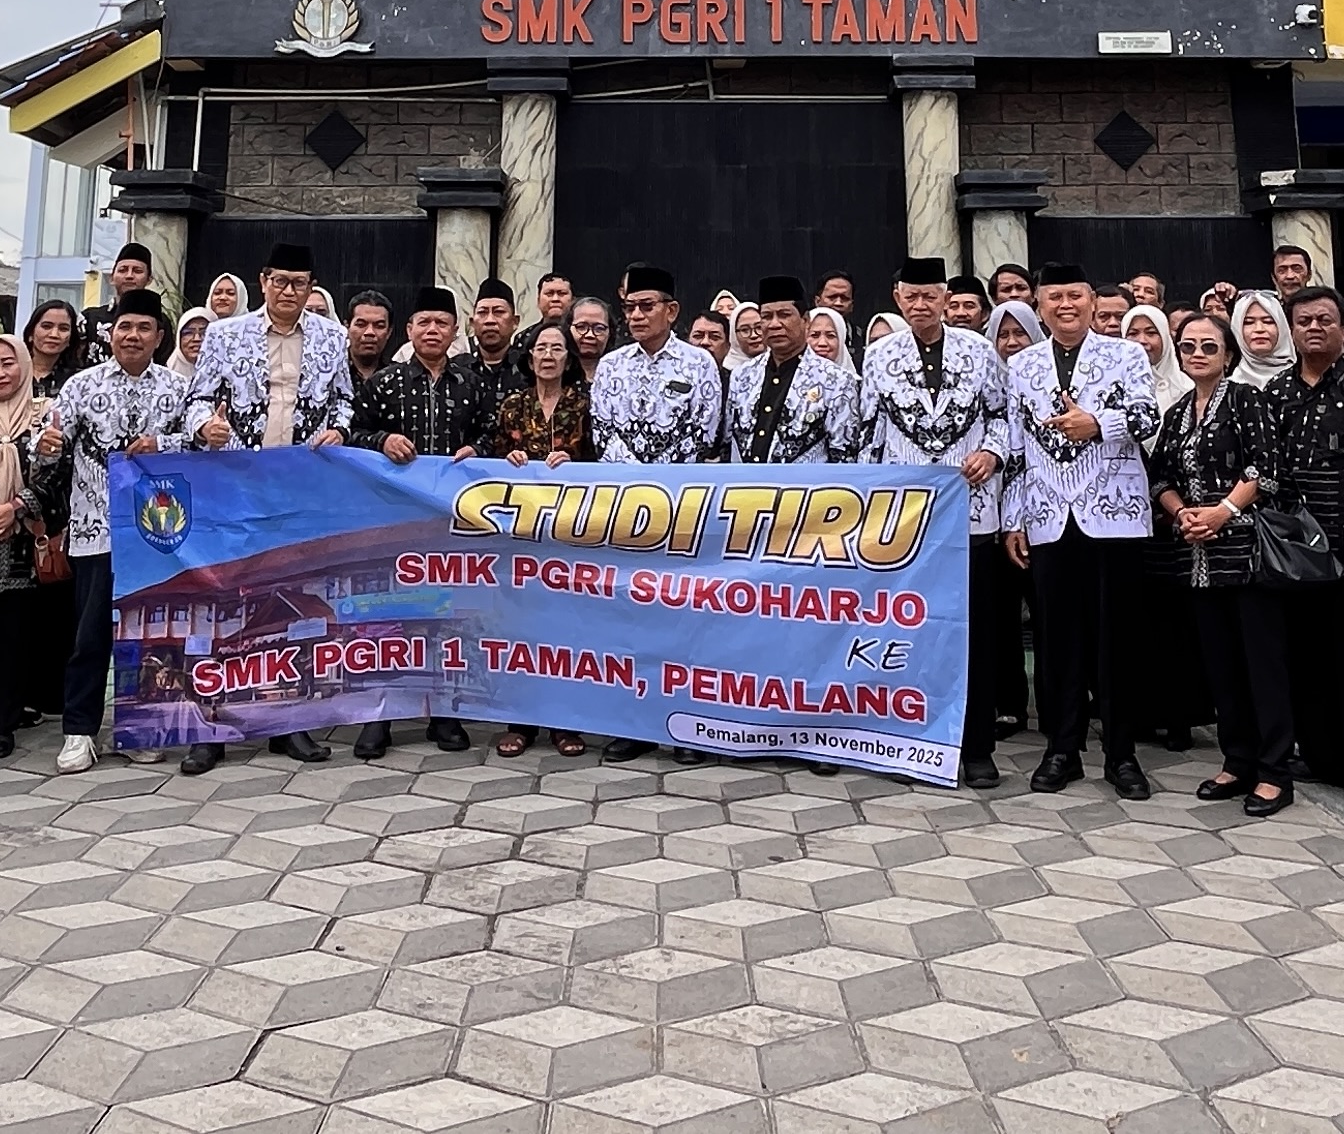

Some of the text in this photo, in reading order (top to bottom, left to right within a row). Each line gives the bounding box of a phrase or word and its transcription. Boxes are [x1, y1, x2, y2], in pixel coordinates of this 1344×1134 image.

[453, 481, 931, 566] STUDI TIRU
[396, 554, 927, 628] SMK PGRI SUKOHARJO
[193, 637, 927, 722] SMK PGRI 1 TAMAN, PEMALANG
[846, 637, 908, 672] KE
[696, 722, 944, 767] Pemalang, 13 November 2025
